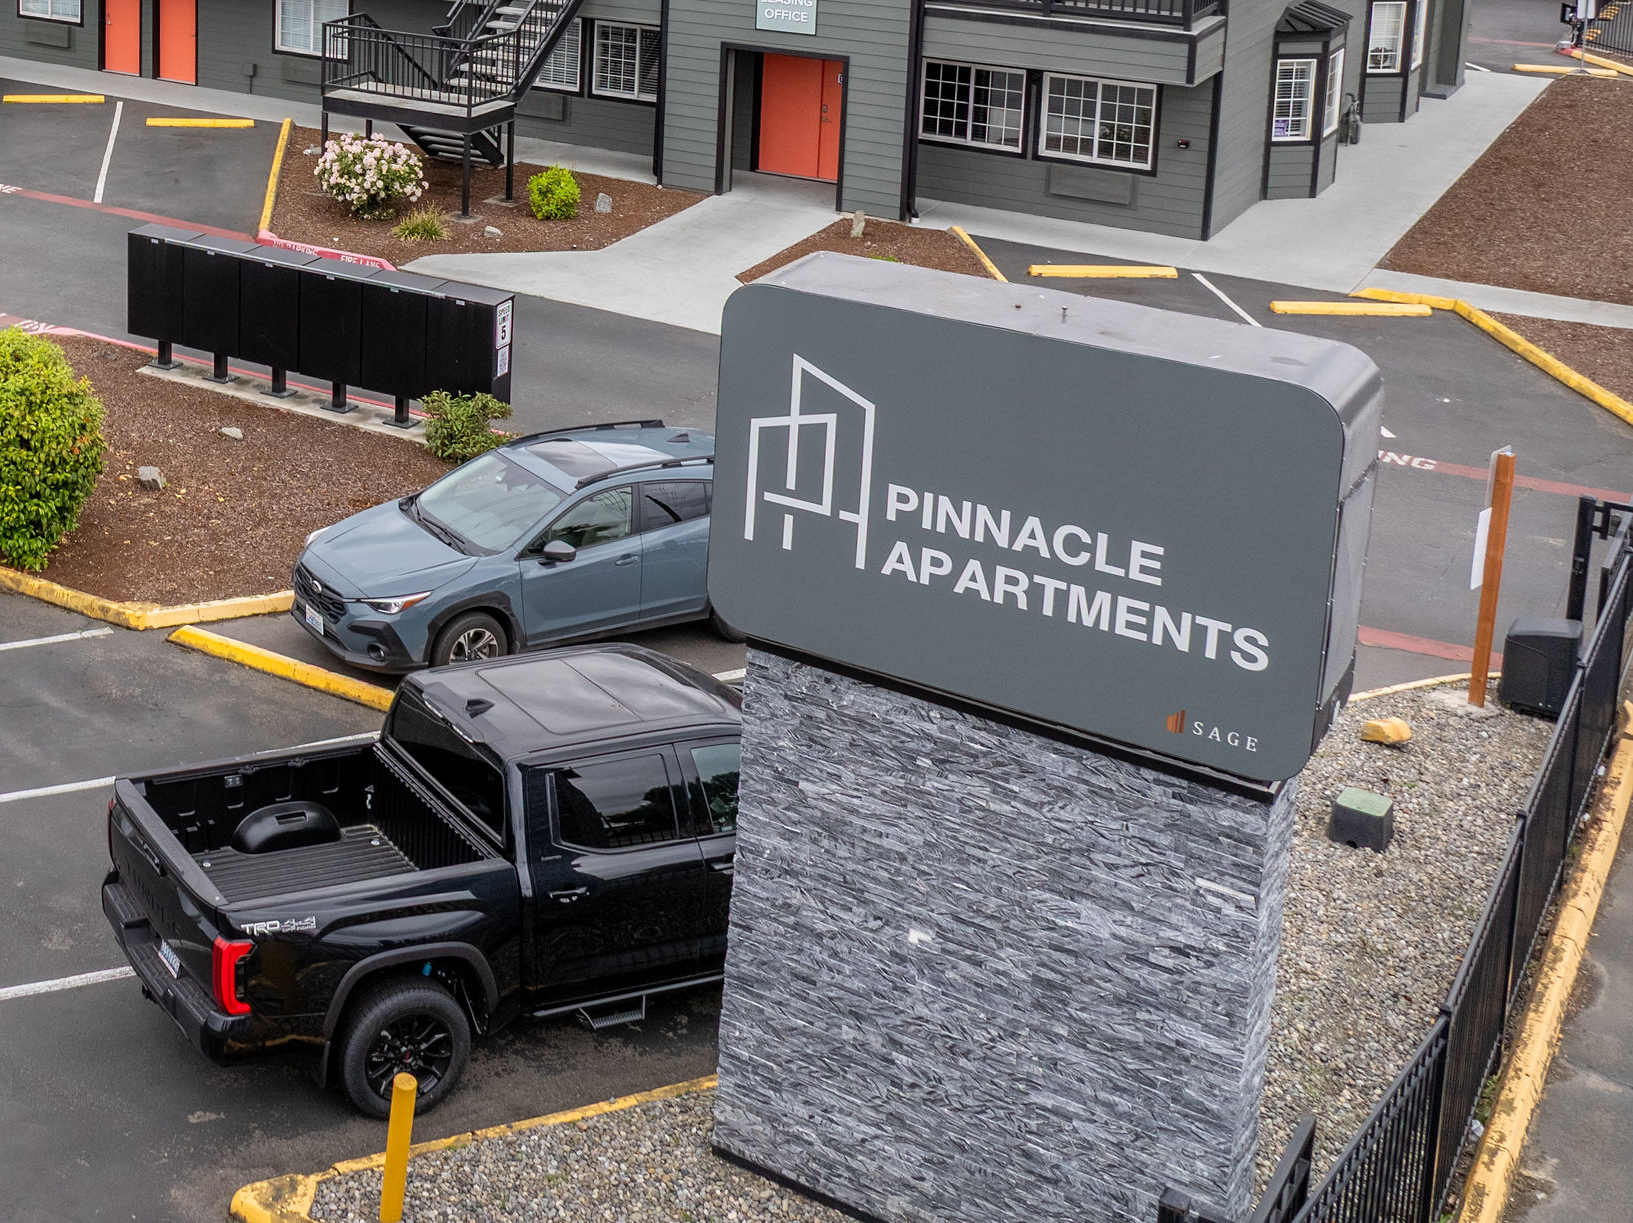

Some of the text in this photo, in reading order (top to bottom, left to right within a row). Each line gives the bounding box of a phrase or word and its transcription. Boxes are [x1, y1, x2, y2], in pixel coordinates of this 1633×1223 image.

[764, 8, 809, 22] OFFICE
[340, 255, 358, 264] FIRE
[359, 259, 381, 269] LANE
[501, 325, 507, 341] 5
[886, 483, 1165, 587] PINNACLE
[881, 541, 1270, 672] APARTMENTS
[1192, 721, 1258, 752] SAGE
[241, 920, 281, 936] TRD
